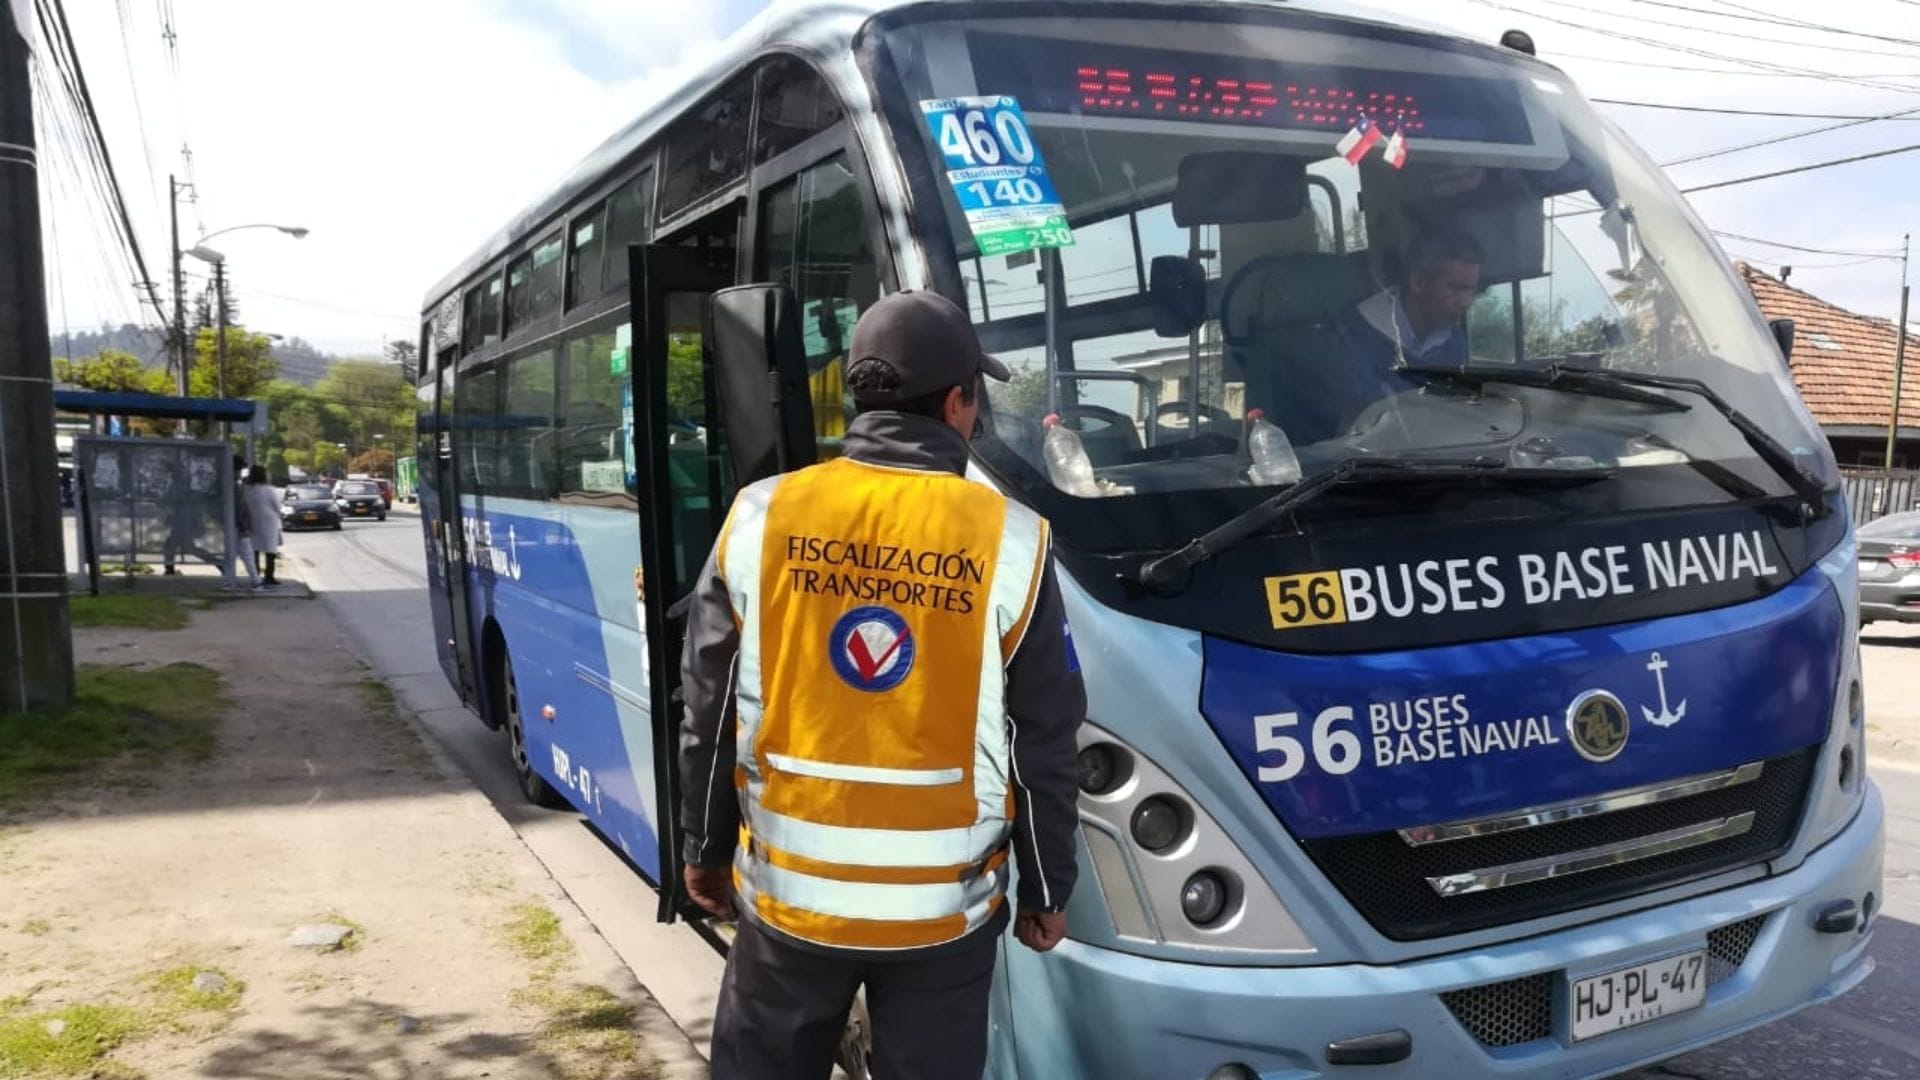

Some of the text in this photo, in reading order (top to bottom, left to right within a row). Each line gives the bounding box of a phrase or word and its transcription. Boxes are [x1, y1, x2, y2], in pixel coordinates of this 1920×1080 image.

[940, 110, 1034, 165] 460
[967, 178, 1043, 207] 140
[1024, 227, 1072, 246] 250
[787, 536, 985, 584] FISCALIZACIÓN
[1278, 529, 1778, 623] 56 BUSES BASE NAVAL
[788, 568, 973, 614] TRANSPORTES
[1369, 694, 1470, 735] BUSES
[1253, 705, 1363, 783] 56
[1373, 715, 1560, 767] BASE NAVAL
